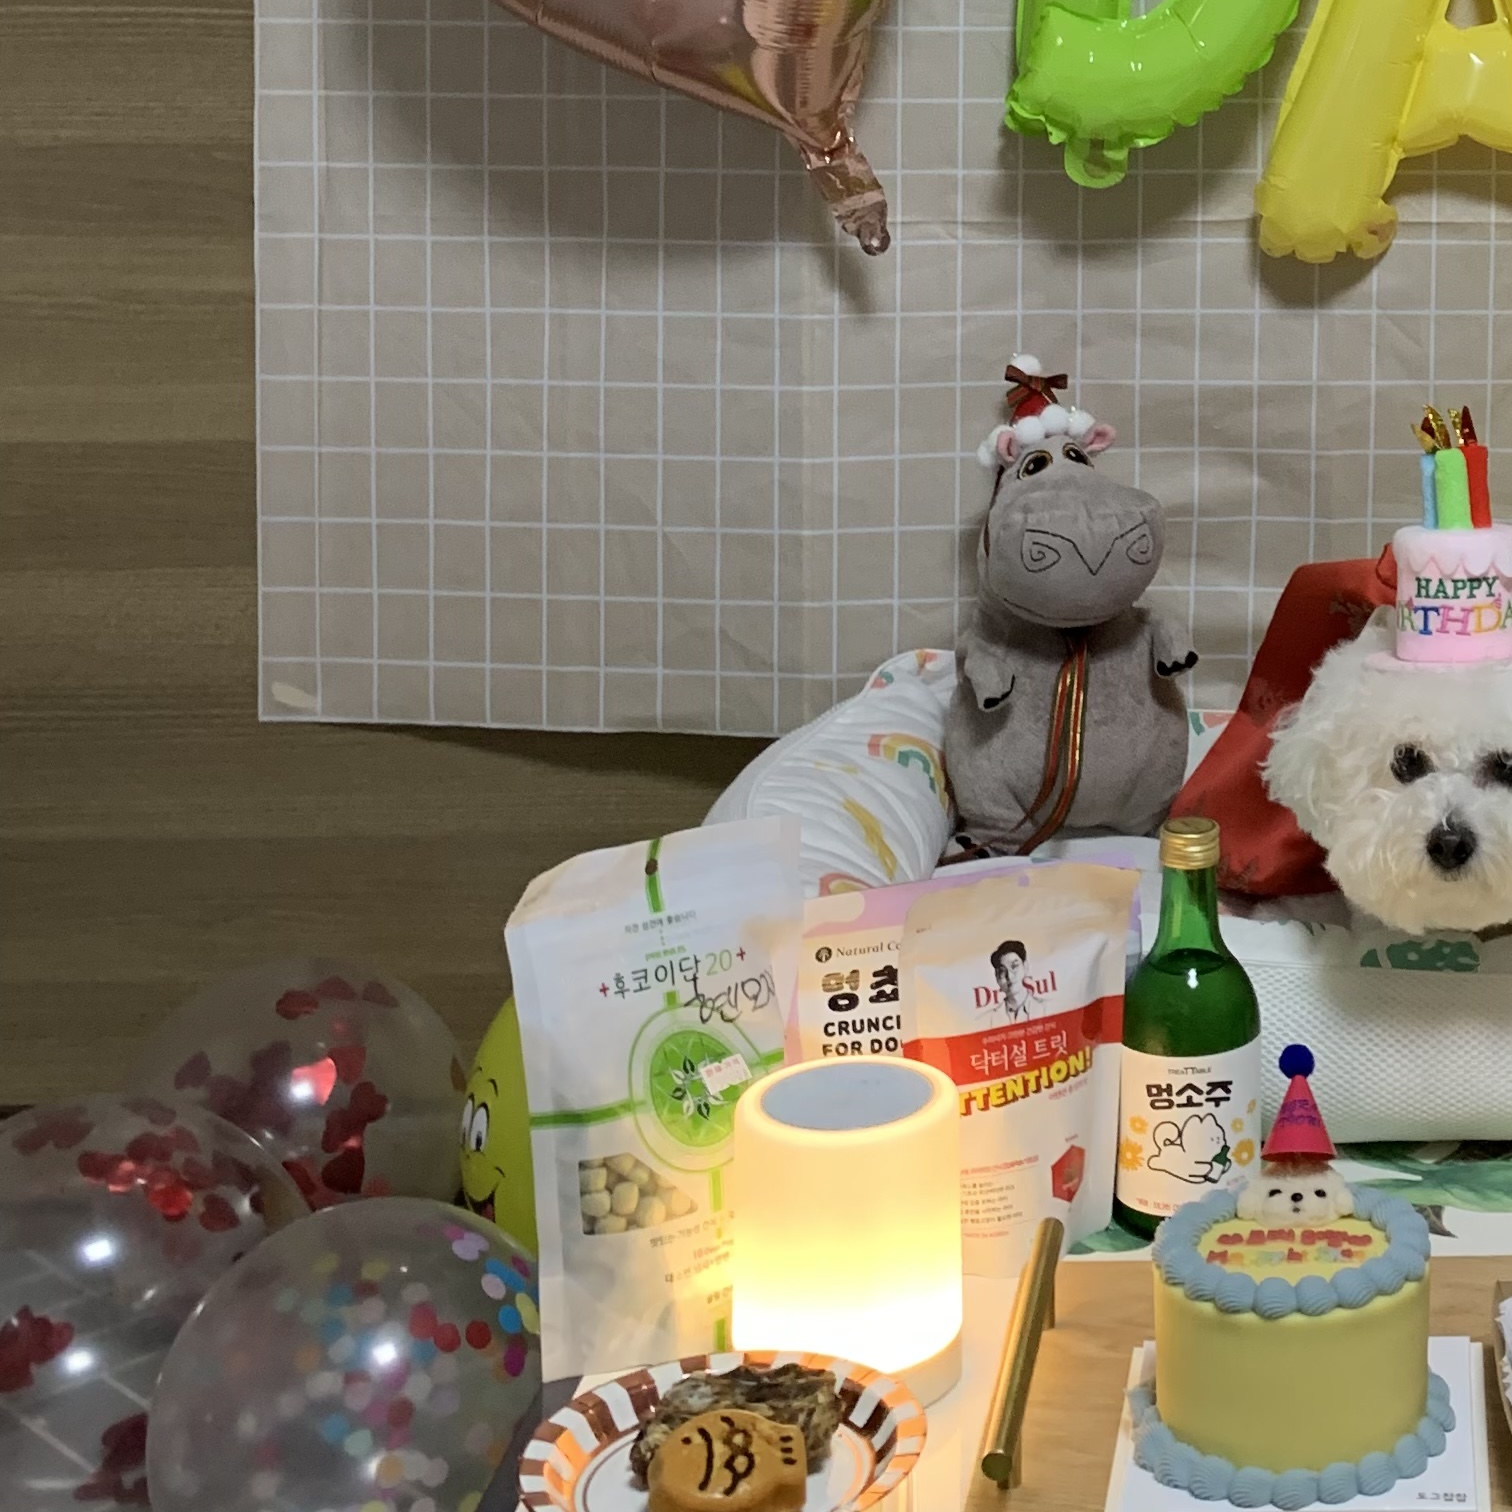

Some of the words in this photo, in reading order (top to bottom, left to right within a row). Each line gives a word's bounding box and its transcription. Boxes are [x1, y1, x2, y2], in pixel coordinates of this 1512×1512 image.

[1415, 576, 1499, 599] HAPPY
[836, 941, 884, 957] Natural
[613, 954, 701, 1000] 후코이단
[705, 949, 732, 976] 20
[1022, 970, 1058, 996] Sul
[822, 1040, 863, 1057] FOR
[870, 1037, 901, 1054] DO
[970, 1039, 1028, 1076] 닥터설
[1033, 1029, 1068, 1061] 트릿
[1145, 1080, 1233, 1110] 멍소주
